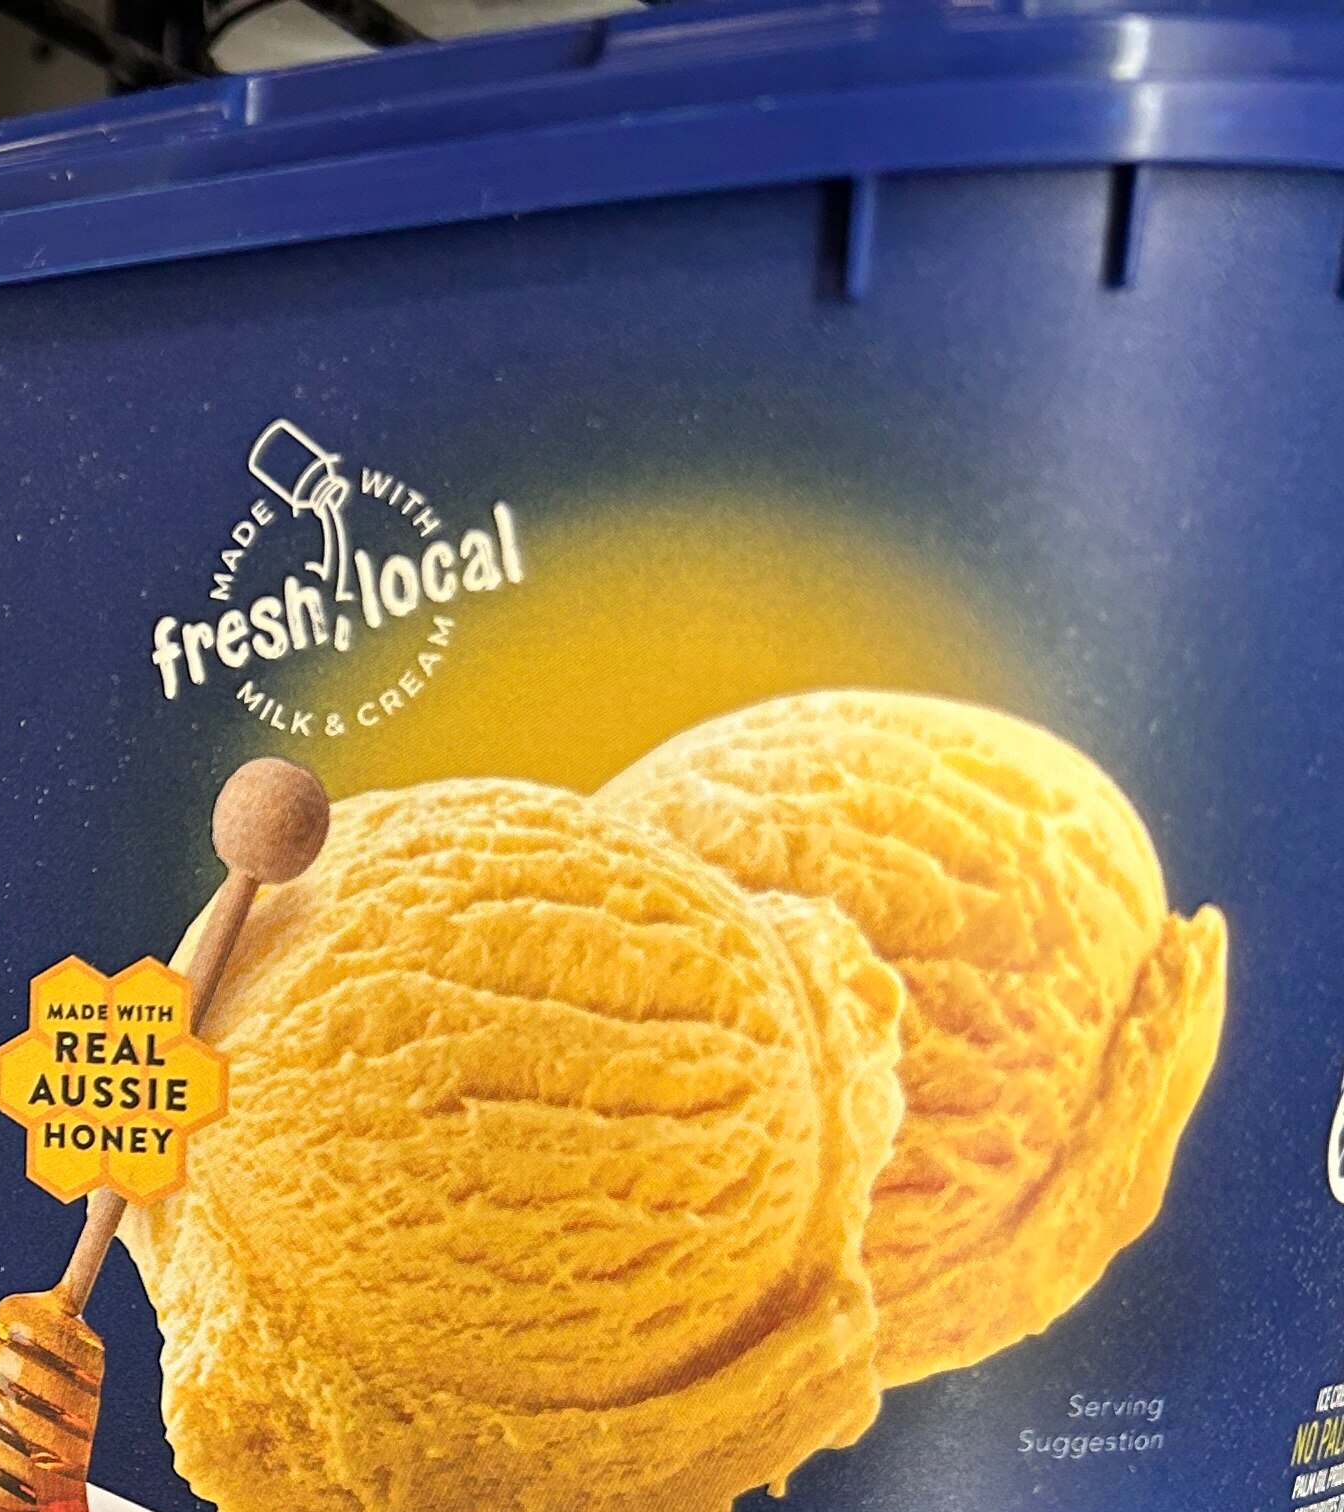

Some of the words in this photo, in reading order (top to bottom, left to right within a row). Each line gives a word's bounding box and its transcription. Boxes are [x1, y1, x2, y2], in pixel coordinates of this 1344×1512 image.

[209, 498, 275, 600] MADE
[361, 467, 440, 537] WITH
[152, 576, 330, 700] fresh
[354, 502, 524, 629] local
[236, 680, 312, 737] MILK
[324, 712, 346, 737] &
[356, 615, 455, 727] CREAM
[47, 1003, 108, 1020] MADE
[117, 1004, 173, 1022] WITH
[55, 1031, 165, 1066] REAL
[28, 1074, 188, 1111] AUSSIE
[44, 1123, 173, 1154] HONEY
[1068, 1394, 1165, 1423] Serving
[1017, 1429, 1165, 1460] Suggestion
[1290, 1420, 1319, 1467] NO
